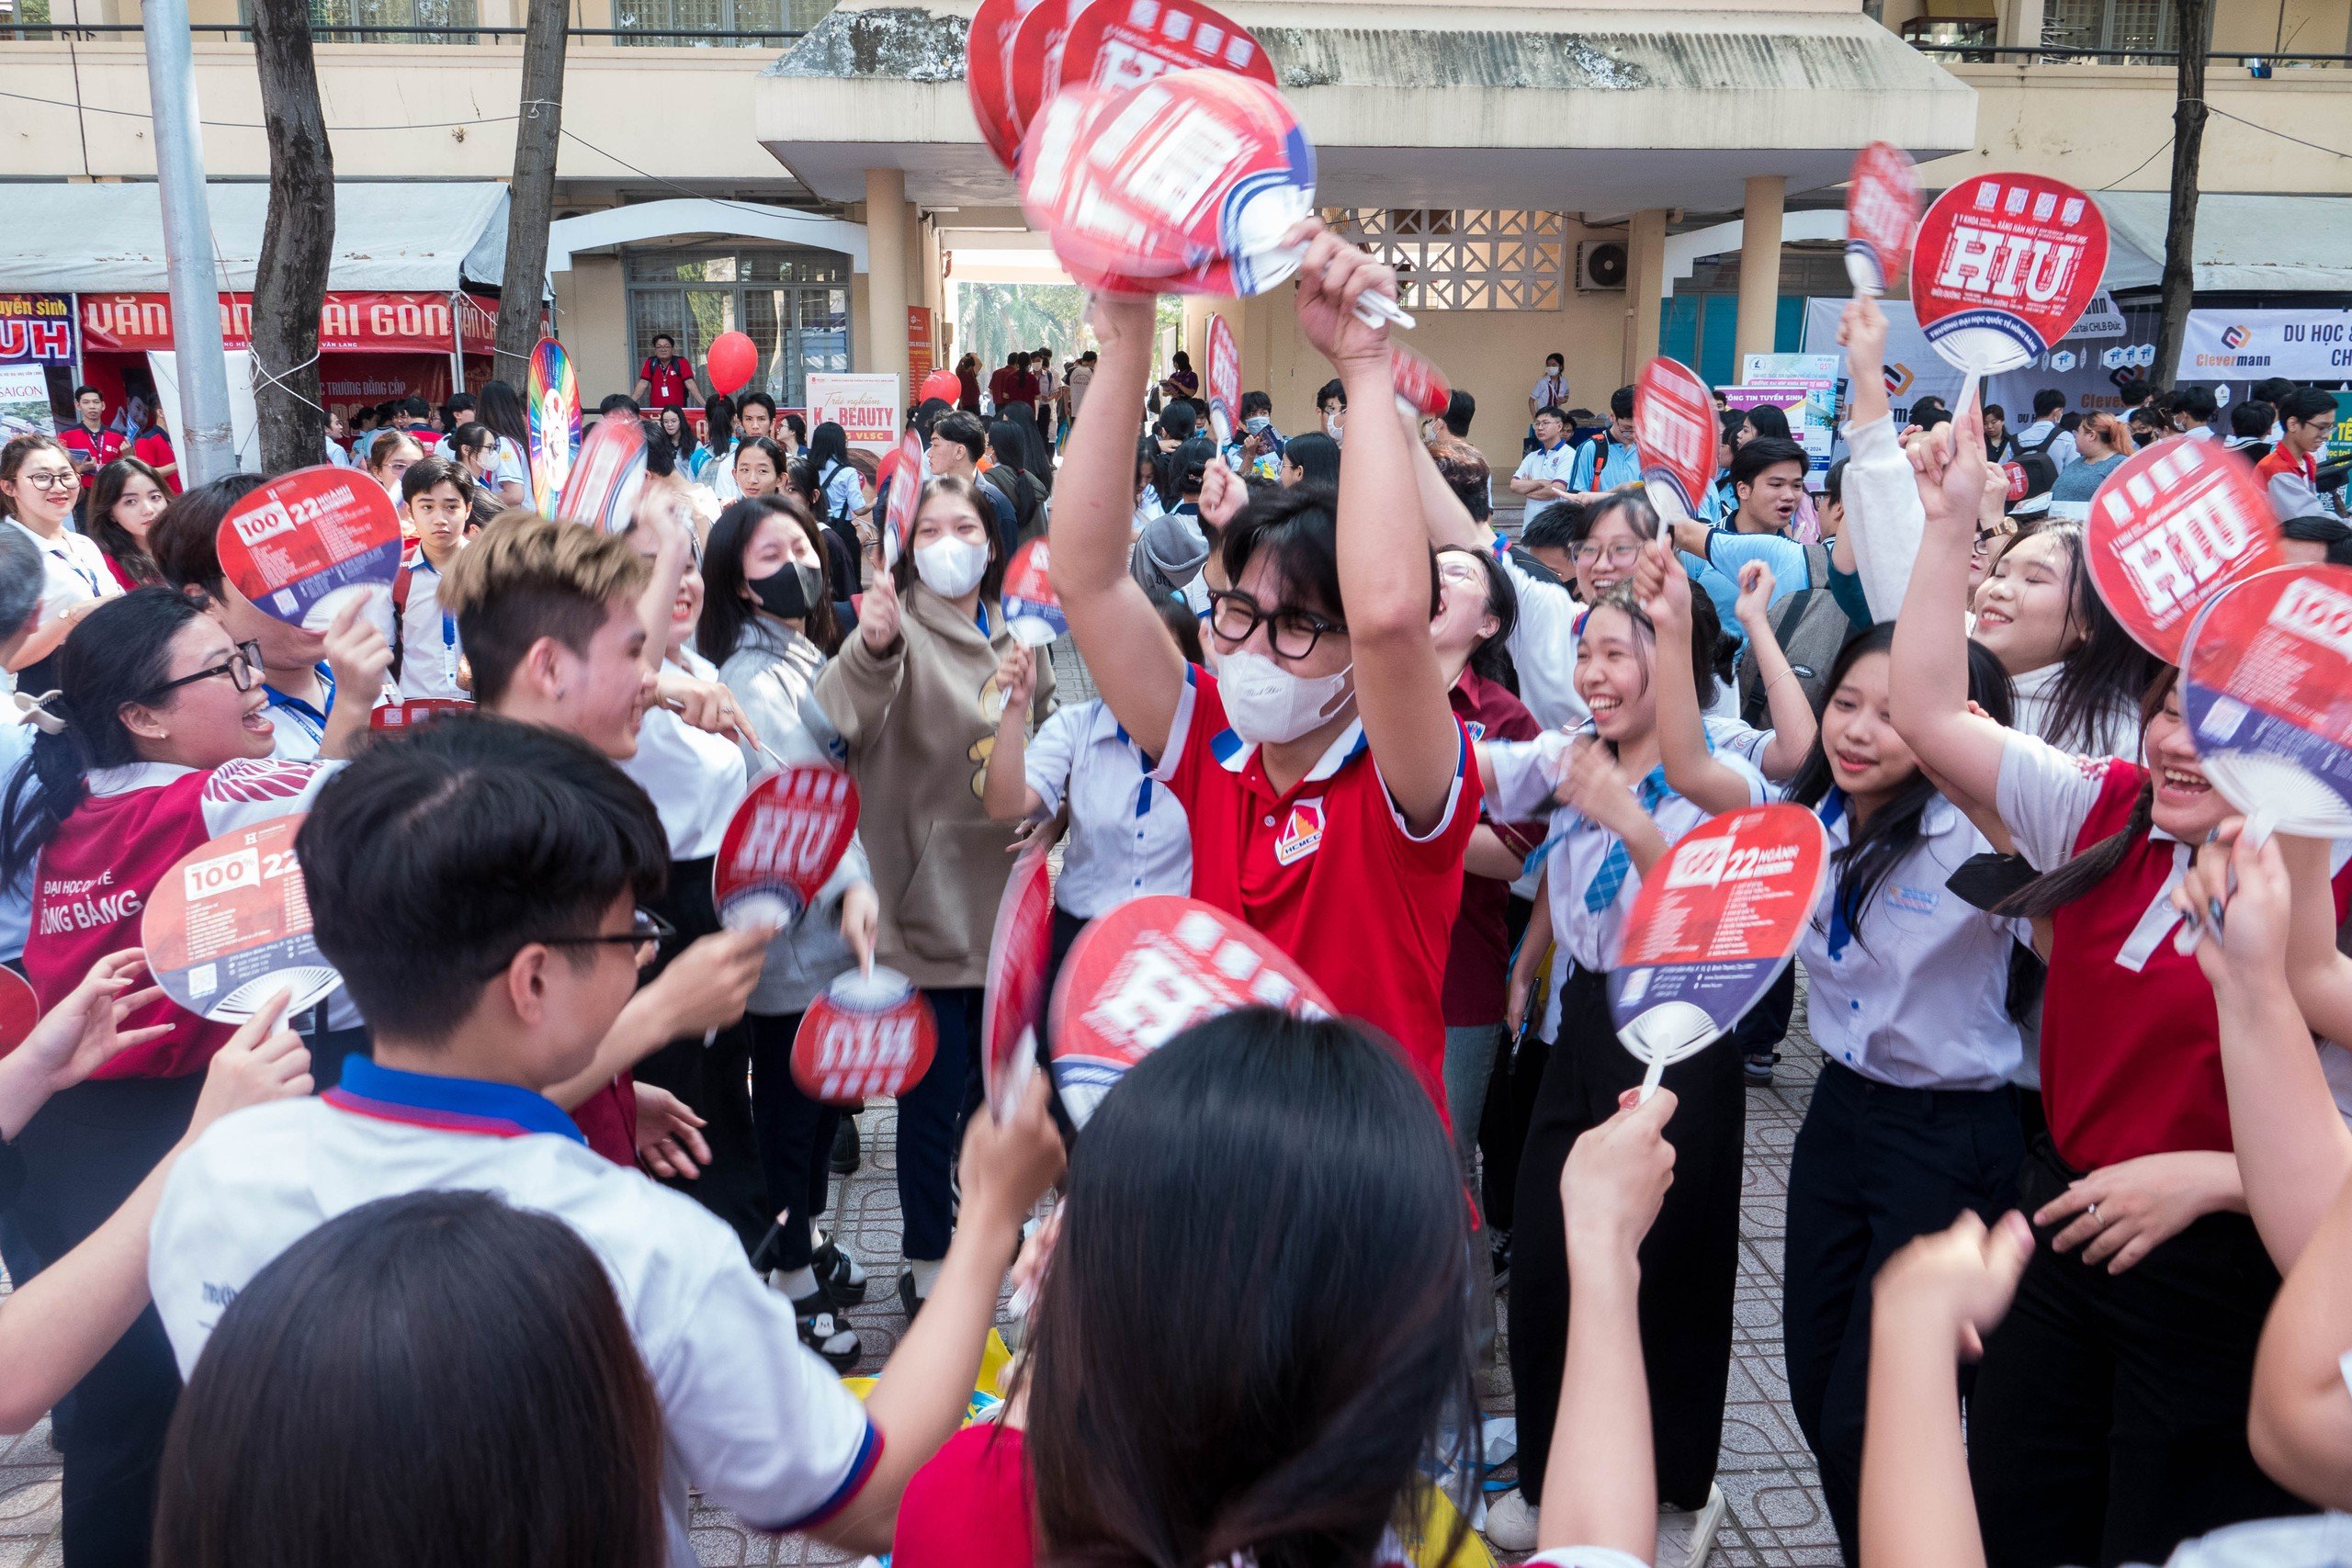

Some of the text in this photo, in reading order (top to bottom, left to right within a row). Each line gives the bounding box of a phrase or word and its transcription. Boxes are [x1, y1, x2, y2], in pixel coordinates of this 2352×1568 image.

[1939, 226, 2076, 302] HIU
[37, 299, 67, 316] sinh
[88, 296, 168, 335] VĂN
[371, 296, 448, 337] GÒN
[2089, 321, 2106, 332] CHLB
[2284, 324, 2344, 346] DU HỌC
[2196, 354, 2270, 367] Clevermann
[327, 378, 361, 396] TRƯỜNG
[363, 376, 387, 396] ĐẲNG
[388, 376, 405, 396] CẤP
[1726, 393, 1743, 401] ÔNG
[1759, 392, 1783, 400] TUYỂN
[814, 407, 823, 425] K
[839, 407, 894, 426] BEAUTY
[856, 432, 883, 440] VLSC
[288, 497, 322, 526] 22
[738, 805, 838, 874] HIU
[1722, 847, 1760, 883] 22
[43, 880, 62, 898] ĐẠI
[62, 880, 84, 897] HỌC
[74, 888, 144, 930] BÀNG
